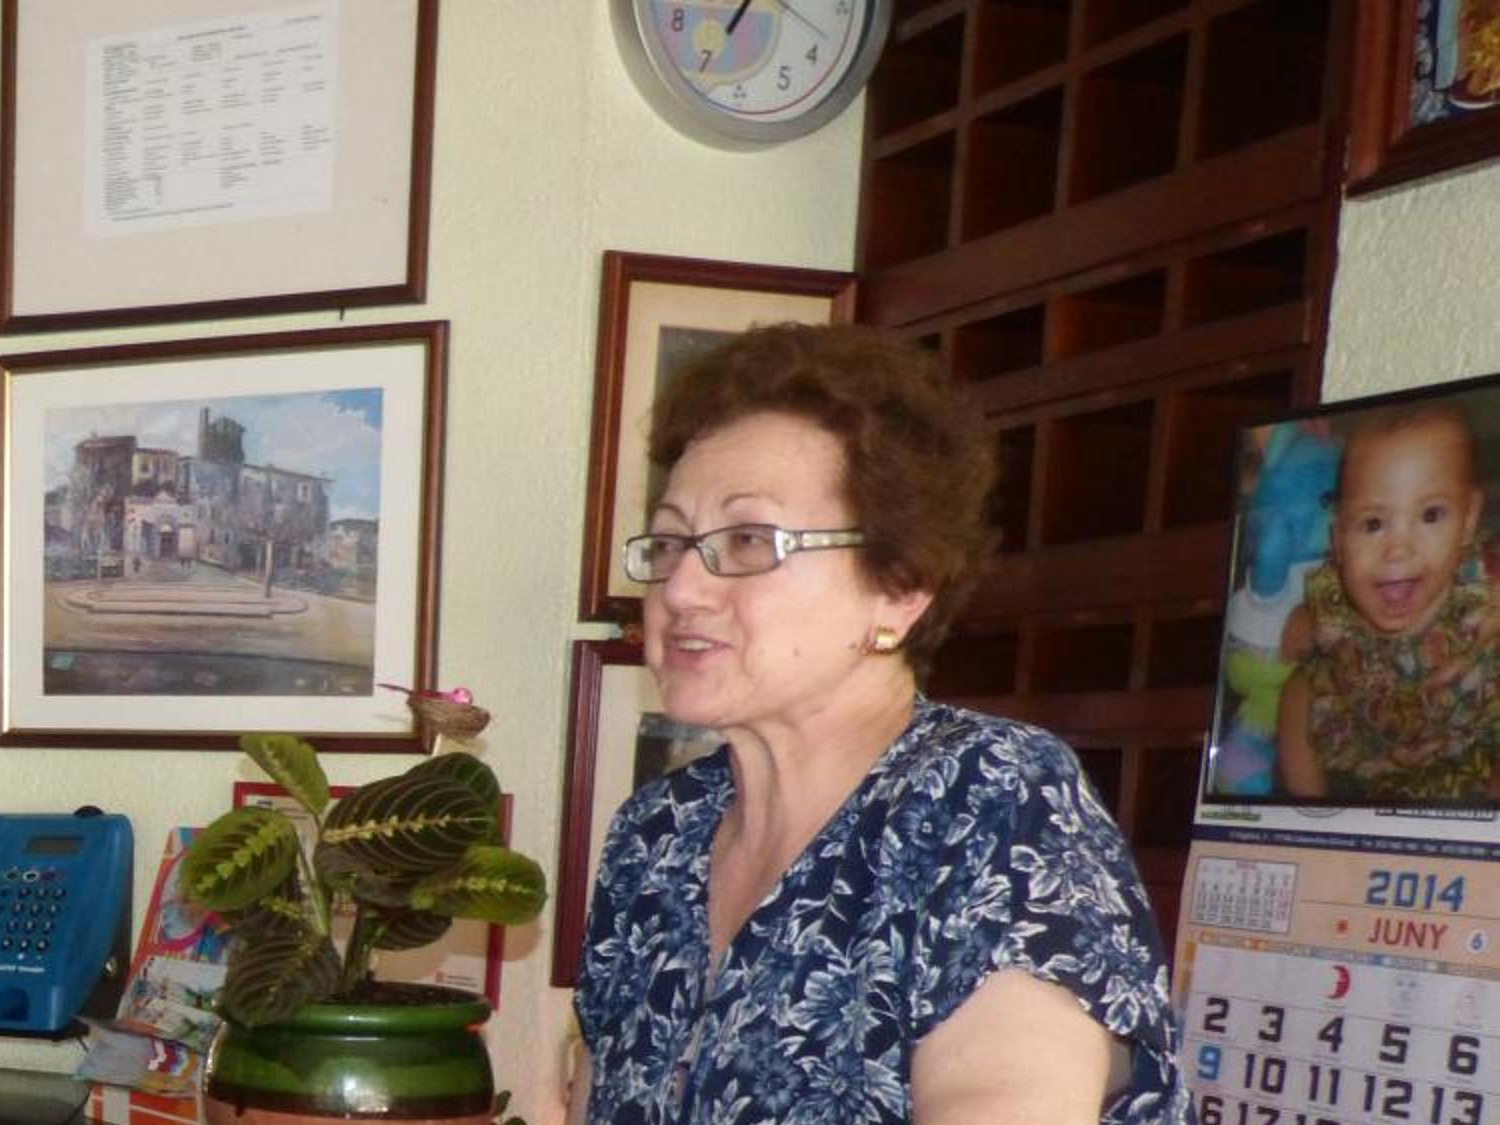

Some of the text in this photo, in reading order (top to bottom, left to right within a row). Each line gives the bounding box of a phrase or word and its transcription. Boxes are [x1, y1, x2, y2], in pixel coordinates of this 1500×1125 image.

[671, 9, 685, 33] 8
[699, 49, 712, 73] 7
[805, 45, 819, 66] 4
[776, 65, 792, 91] 5
[1365, 870, 1466, 912] 2014
[1368, 917, 1449, 949] JUNY
[1203, 997, 1480, 1075] 2 3 4 5 6
[1197, 1046, 1221, 1080] 9
[1244, 1053, 1287, 1094] 10
[1308, 1065, 1340, 1105] 11
[1363, 1075, 1413, 1118] 12
